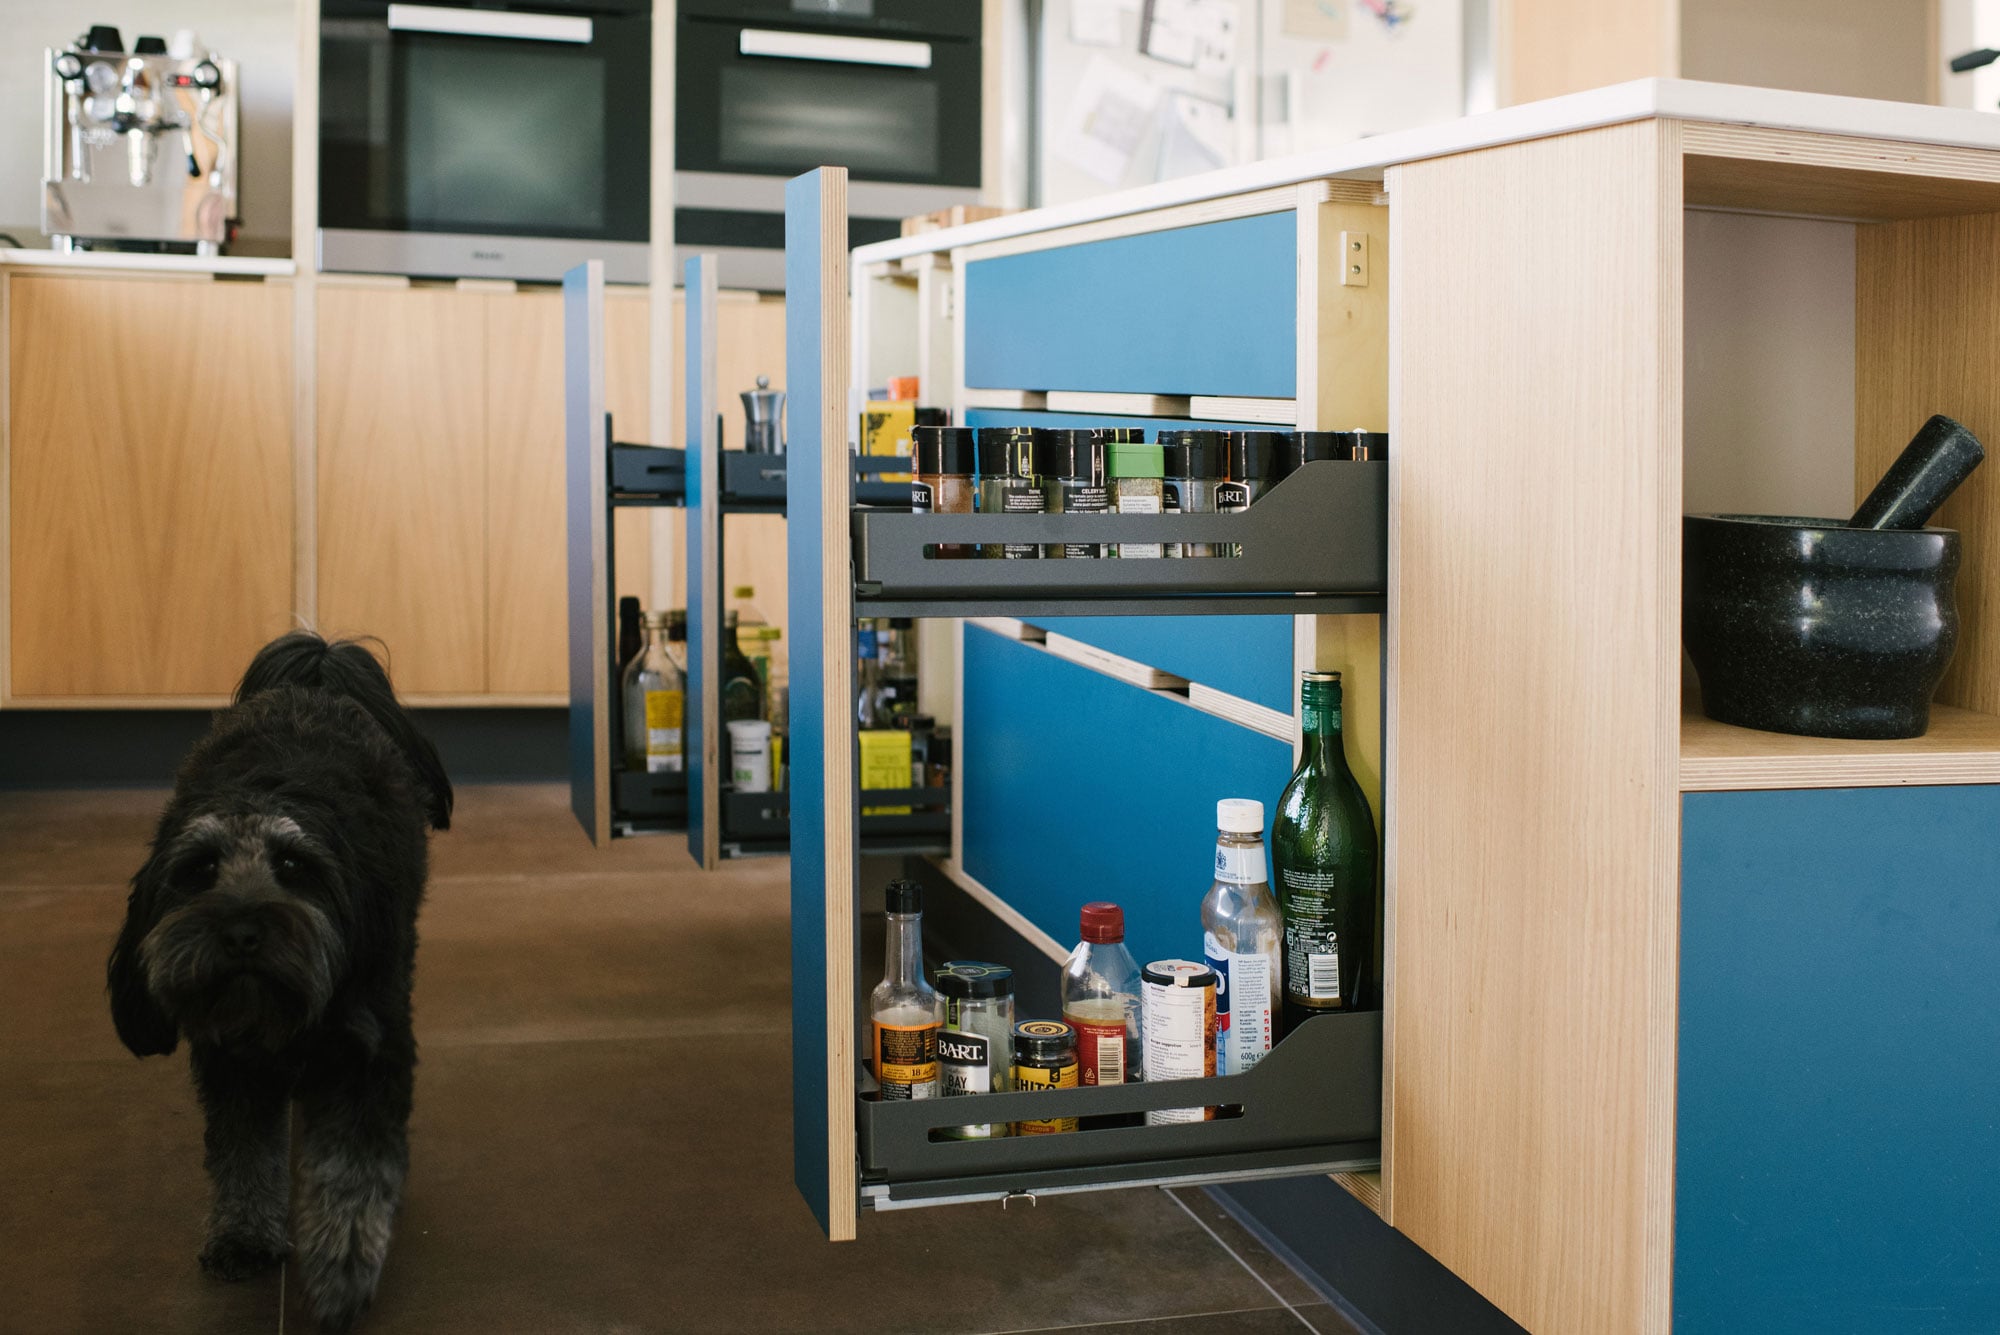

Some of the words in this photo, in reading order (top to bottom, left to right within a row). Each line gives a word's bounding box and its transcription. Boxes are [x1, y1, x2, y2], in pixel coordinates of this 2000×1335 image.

[938, 1039, 984, 1061] BART.
[1240, 1052, 1256, 1062] 600g
[911, 1068, 921, 1077] 18
[948, 1074, 968, 1089] BAY
